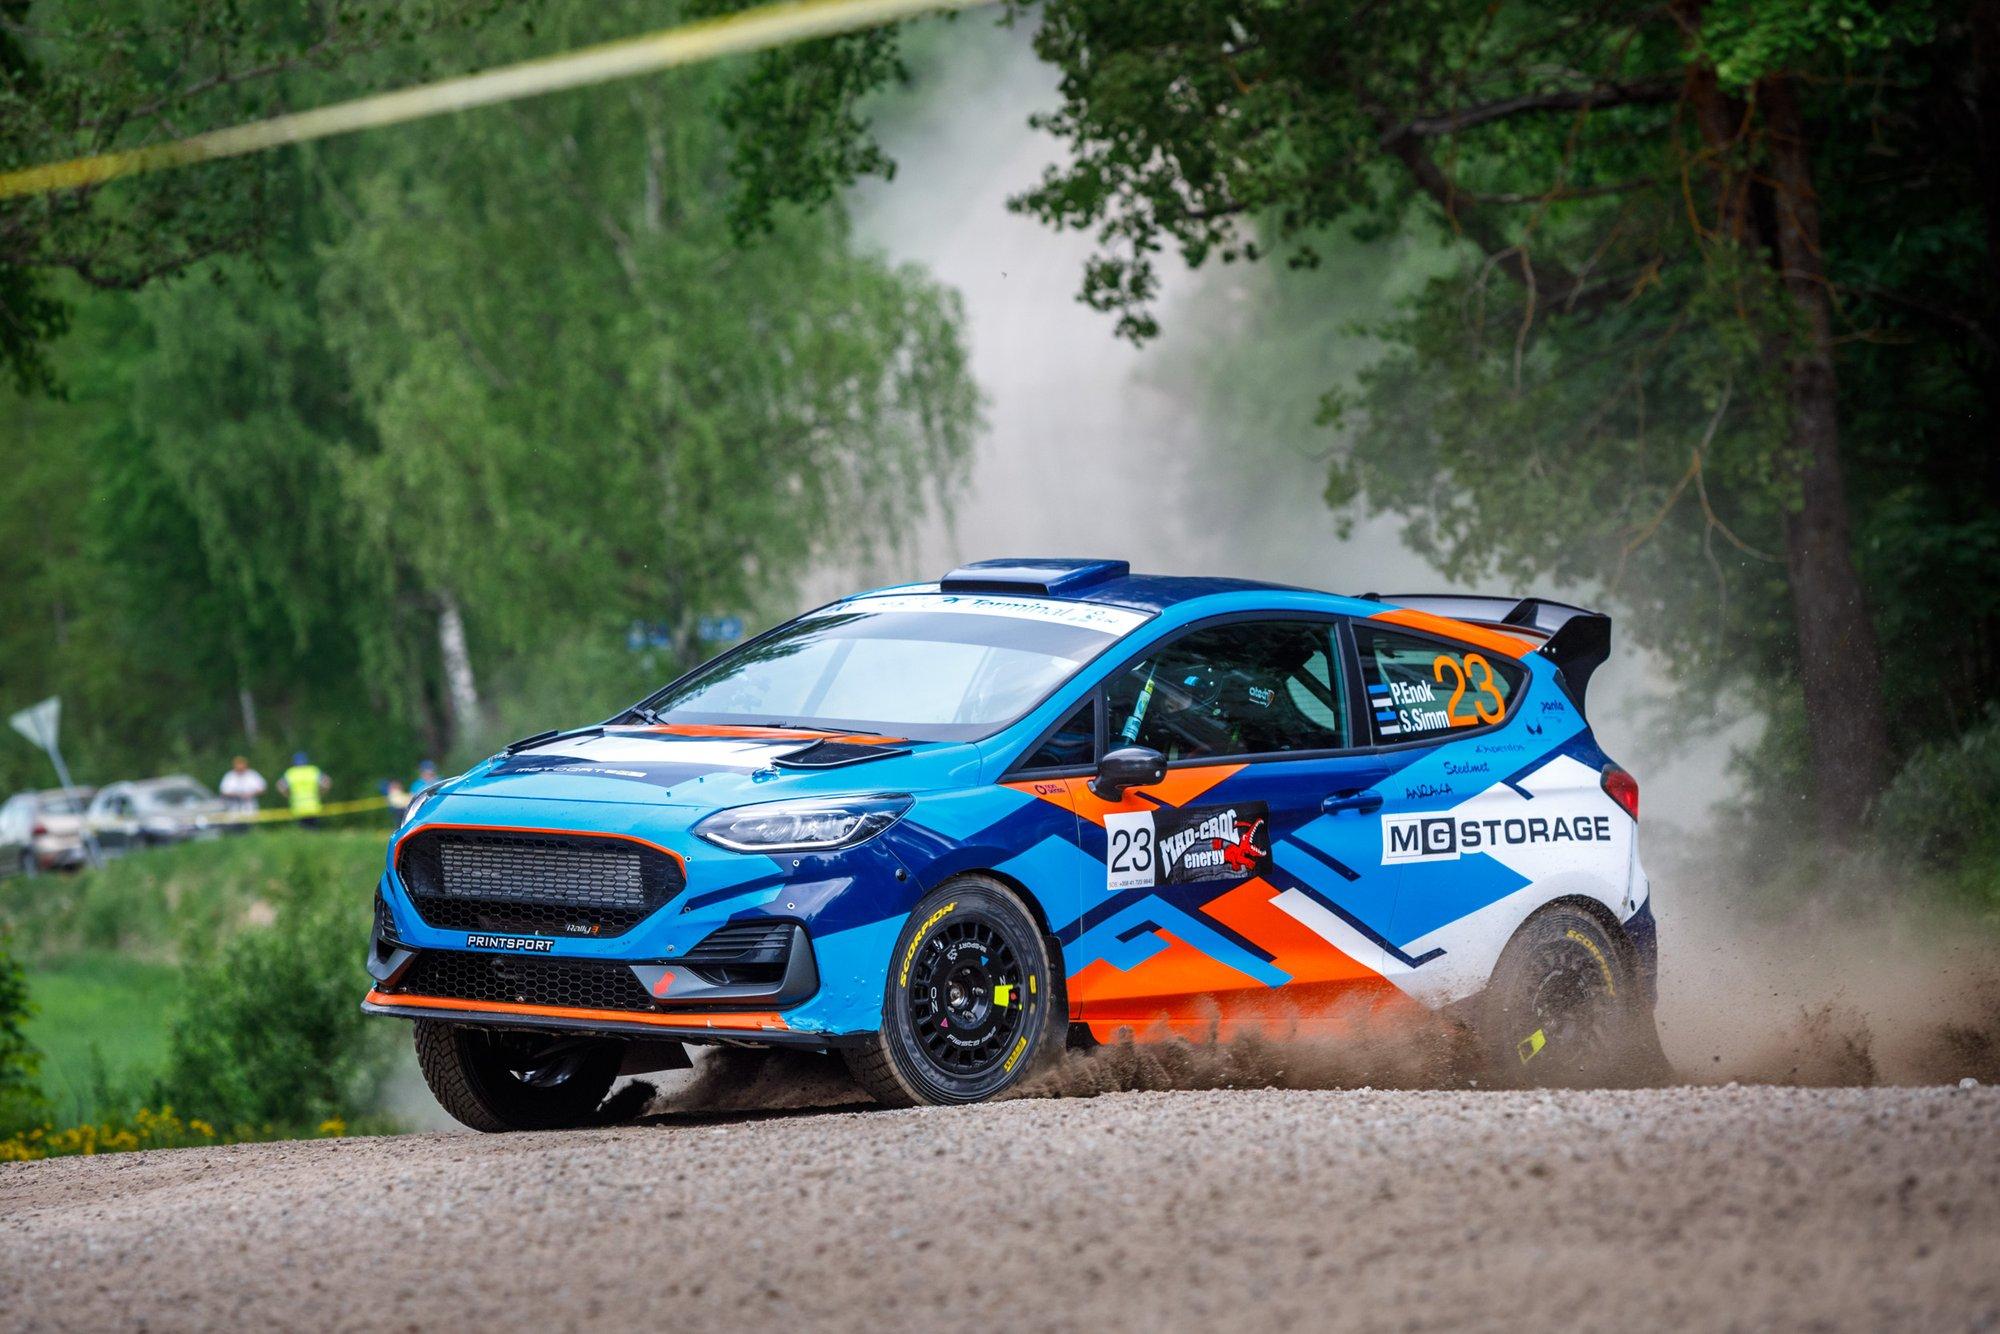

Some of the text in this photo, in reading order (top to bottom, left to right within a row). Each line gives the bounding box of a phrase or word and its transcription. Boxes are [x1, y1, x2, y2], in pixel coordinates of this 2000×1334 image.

[1390, 680, 1436, 706] P.Enok
[1433, 653, 1506, 728] 23
[1400, 708, 1450, 733] S.Simm
[1110, 828, 1151, 874] 23
[1159, 808, 1241, 879] MAD-CROC
[1390, 816, 1611, 853] MG STORAGE
[1184, 848, 1226, 870] energy
[467, 936, 553, 951] PRINTSPORT
[900, 901, 959, 988] SCORPION
